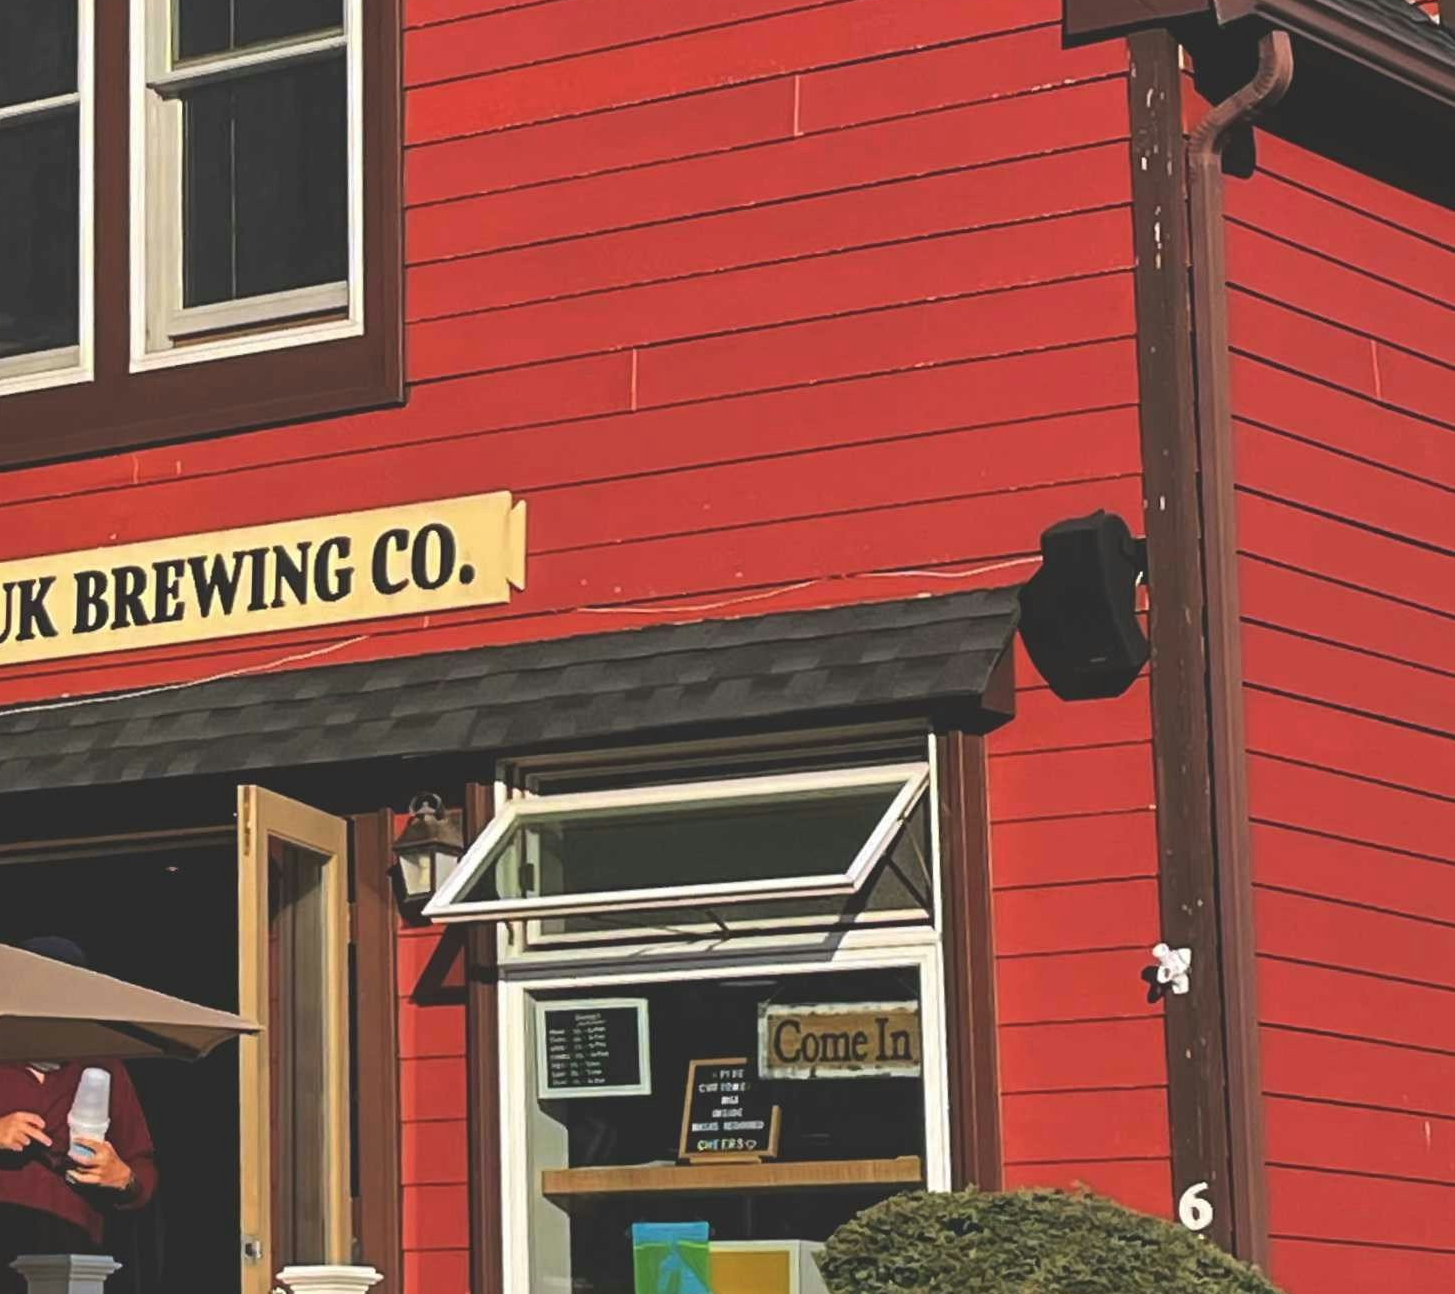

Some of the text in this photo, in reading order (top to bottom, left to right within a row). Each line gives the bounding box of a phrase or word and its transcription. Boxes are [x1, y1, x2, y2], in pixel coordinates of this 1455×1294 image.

[72, 536, 355, 635] BREWING
[371, 522, 476, 596] CO.
[773, 1017, 913, 1063] Come In
[1179, 1181, 1214, 1232] 6
